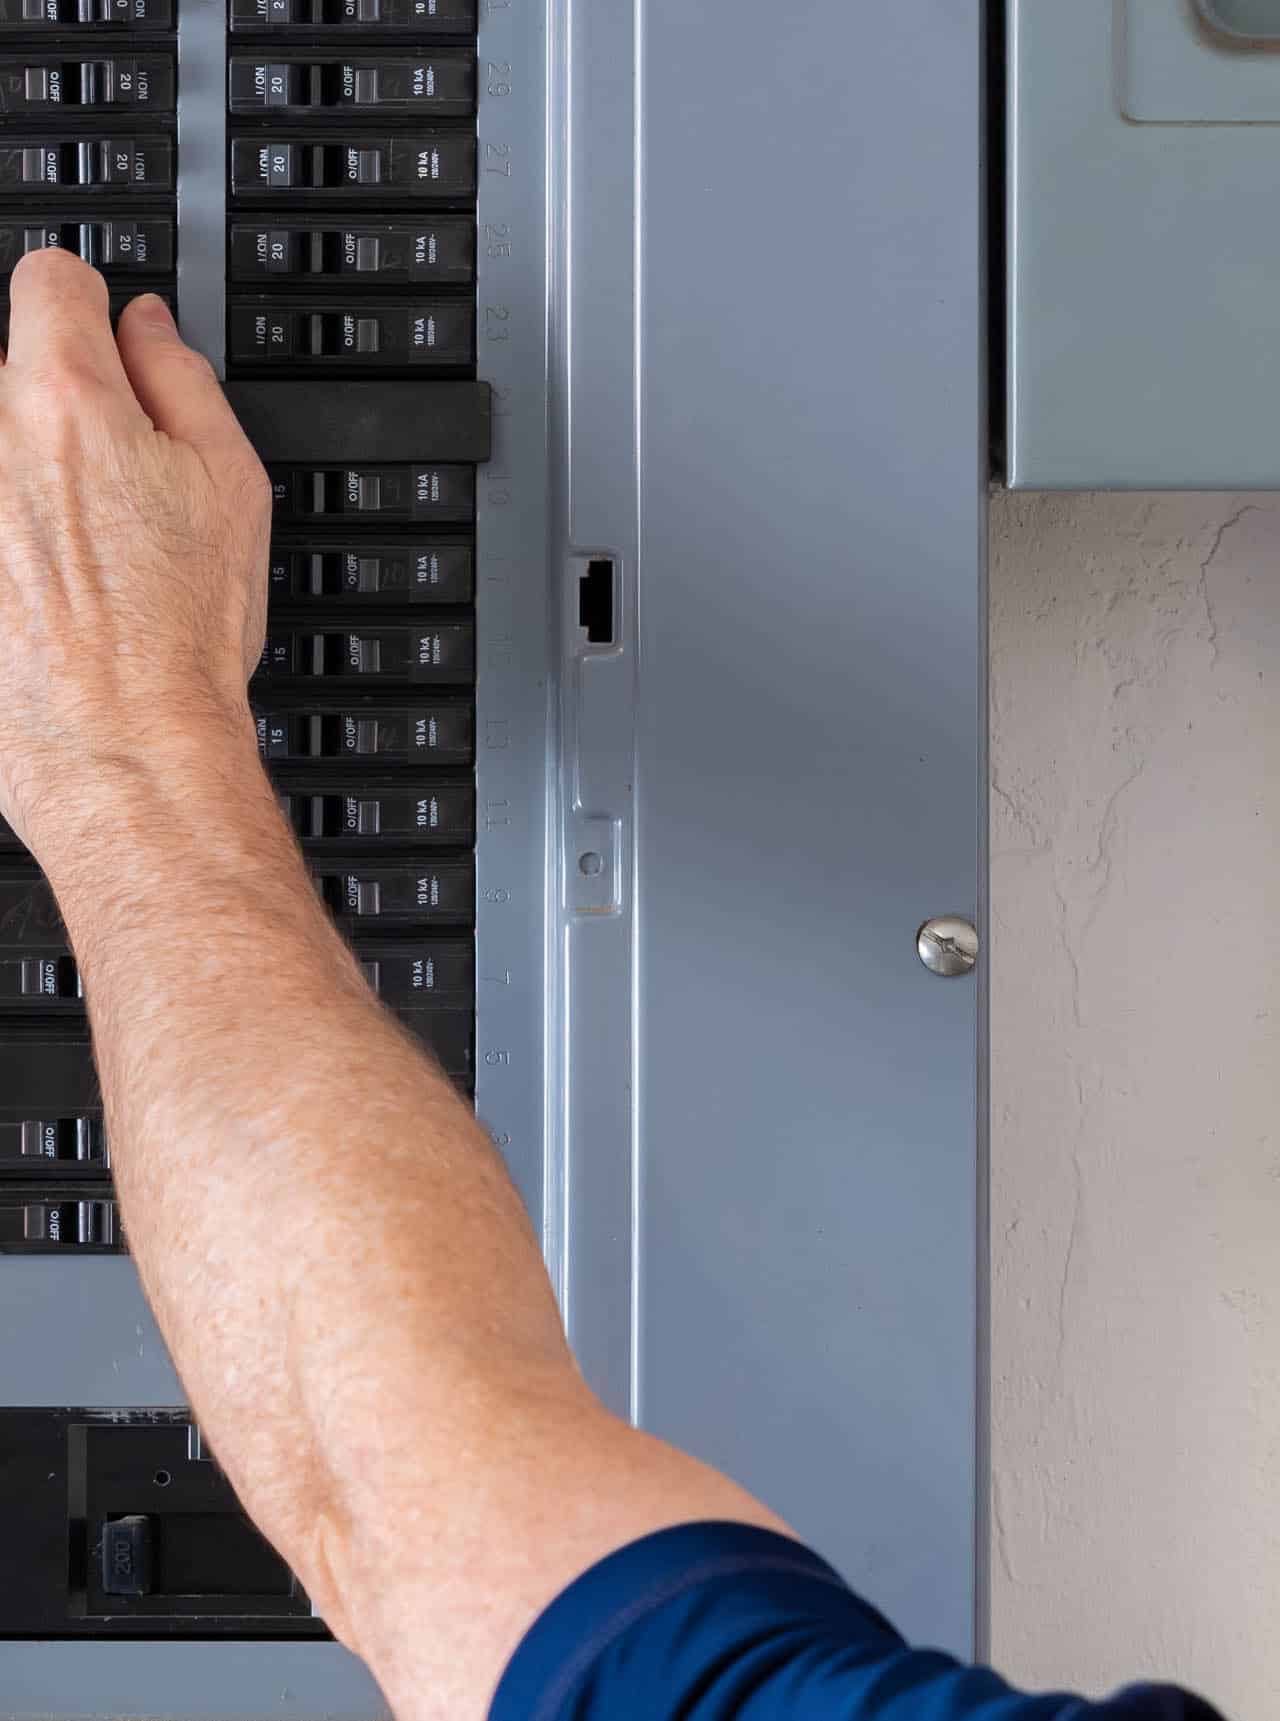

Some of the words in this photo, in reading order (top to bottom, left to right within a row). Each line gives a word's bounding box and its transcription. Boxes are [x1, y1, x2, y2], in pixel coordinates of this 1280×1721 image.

[120, 73, 131, 90] 20
[271, 77, 282, 93] 20
[117, 154, 128, 170] 20
[274, 156, 285, 173] 20
[120, 234, 131, 251] 20
[272, 244, 283, 260] 20
[272, 326, 283, 342] 20
[274, 485, 285, 500] 15
[273, 567, 284, 582] 15
[275, 647, 286, 662] 15
[271, 728, 283, 744] 15
